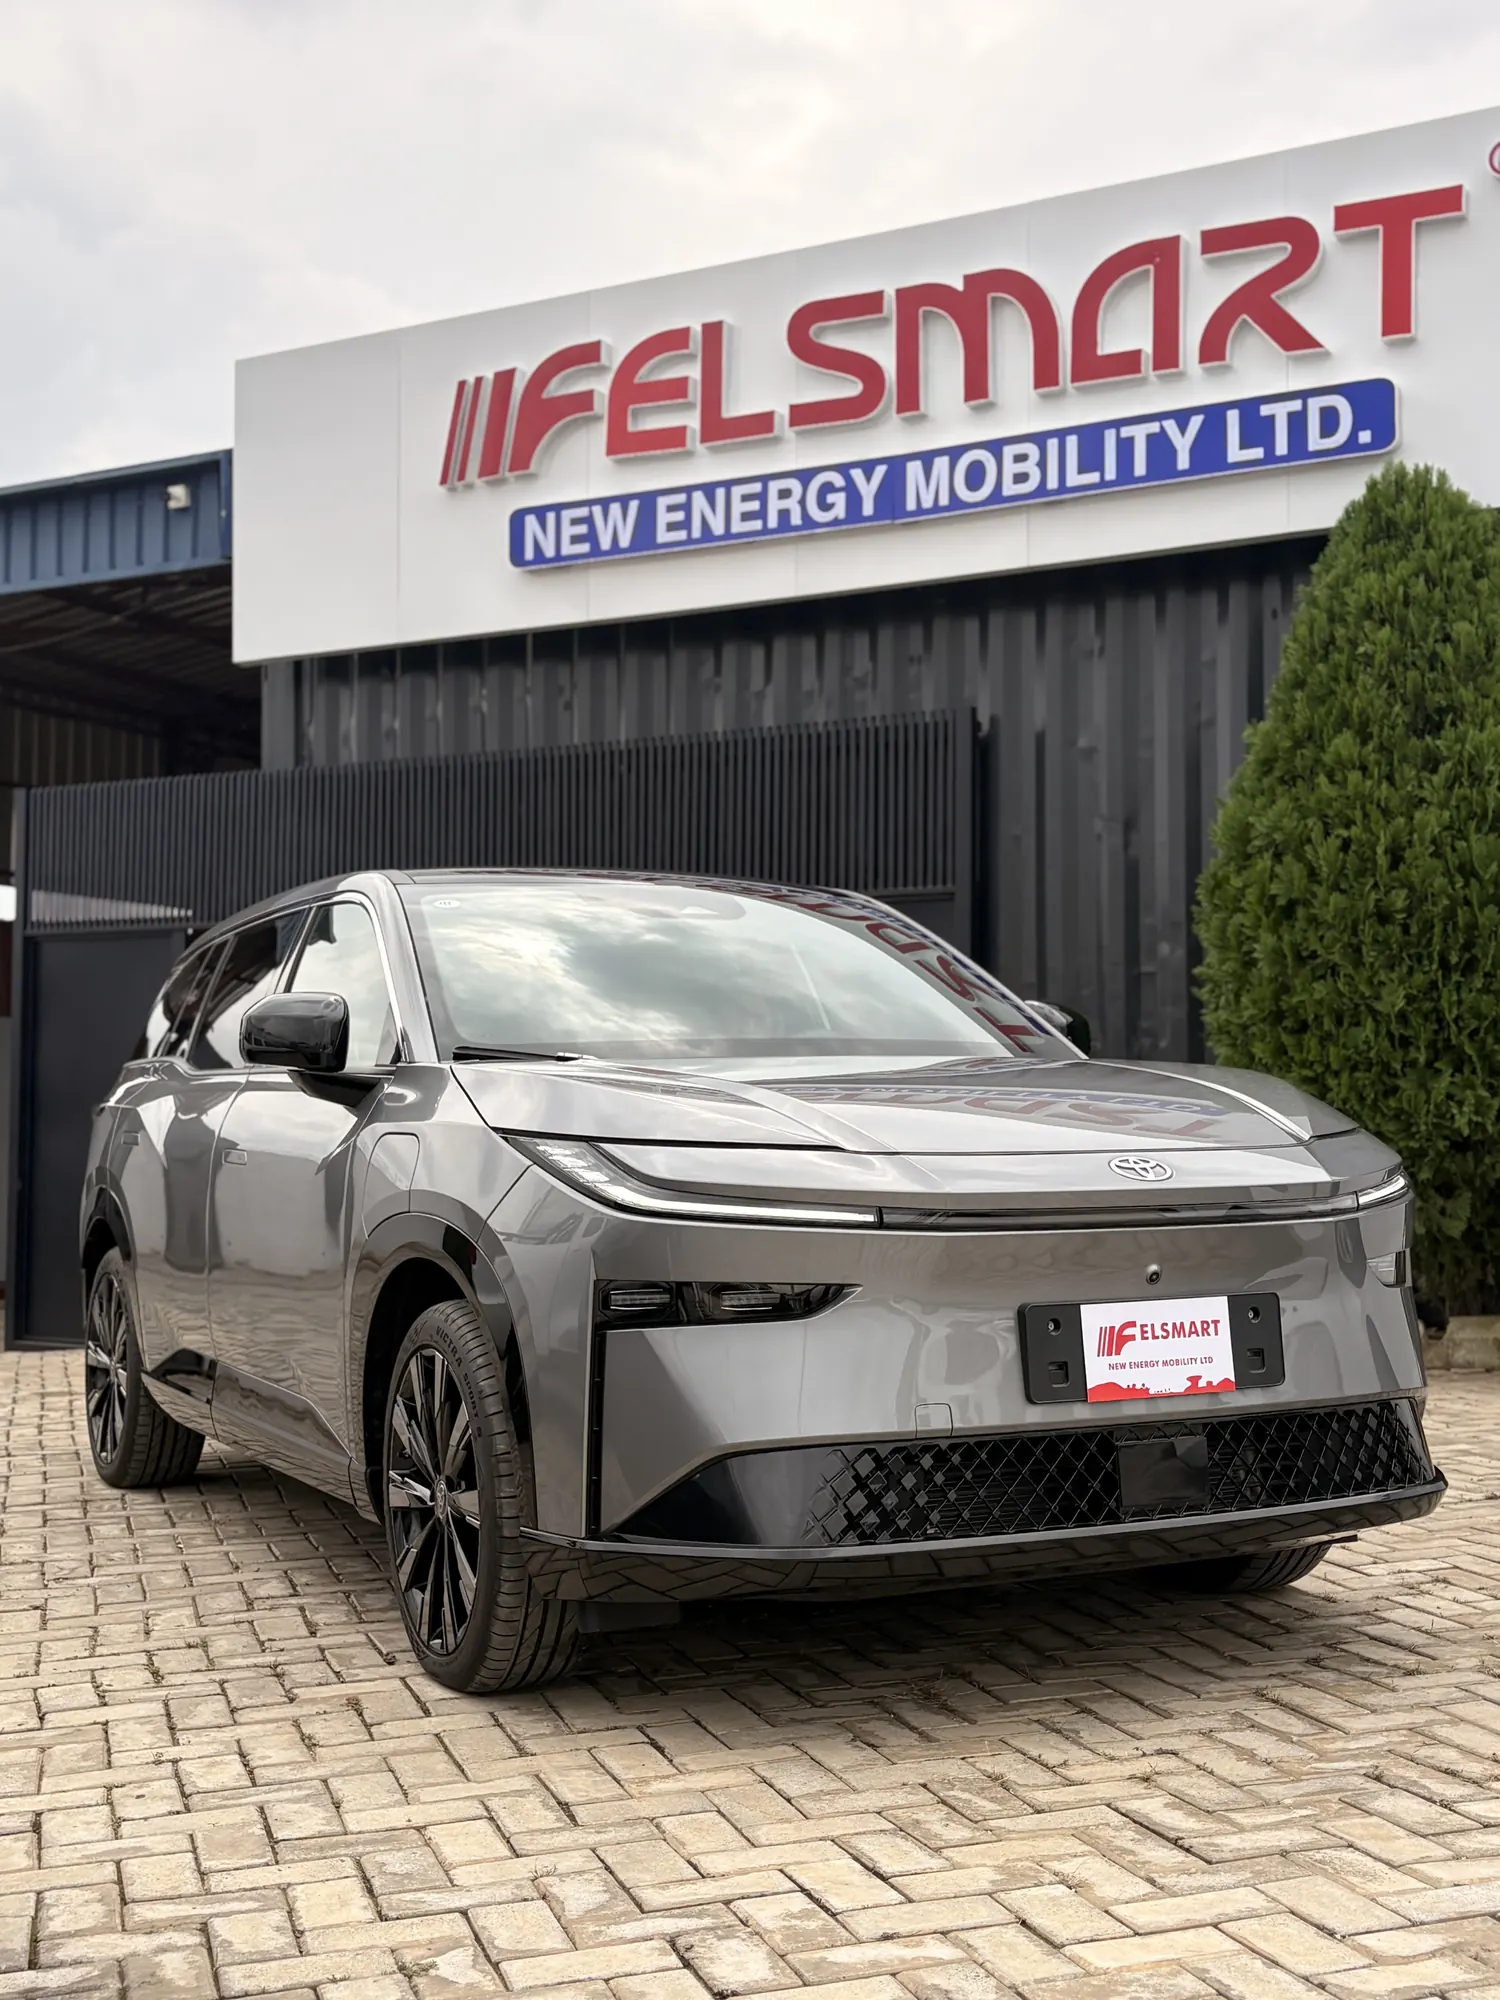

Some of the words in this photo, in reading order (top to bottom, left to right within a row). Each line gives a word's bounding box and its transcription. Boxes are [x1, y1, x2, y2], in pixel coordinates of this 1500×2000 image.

[507, 185, 1464, 473] FELSMART
[524, 499, 640, 561] NEW
[656, 464, 889, 544] ENERGY
[906, 414, 1205, 512] MOBILITY
[1226, 394, 1372, 463] LTD.
[435, 1325, 462, 1367] VICTRA
[1114, 1320, 1220, 1356] FELSMART
[1108, 1362, 1127, 1370] NEW
[1129, 1360, 1160, 1370] ENERGY
[1161, 1357, 1198, 1367] MOBILITY
[1200, 1356, 1214, 1365] LTD
